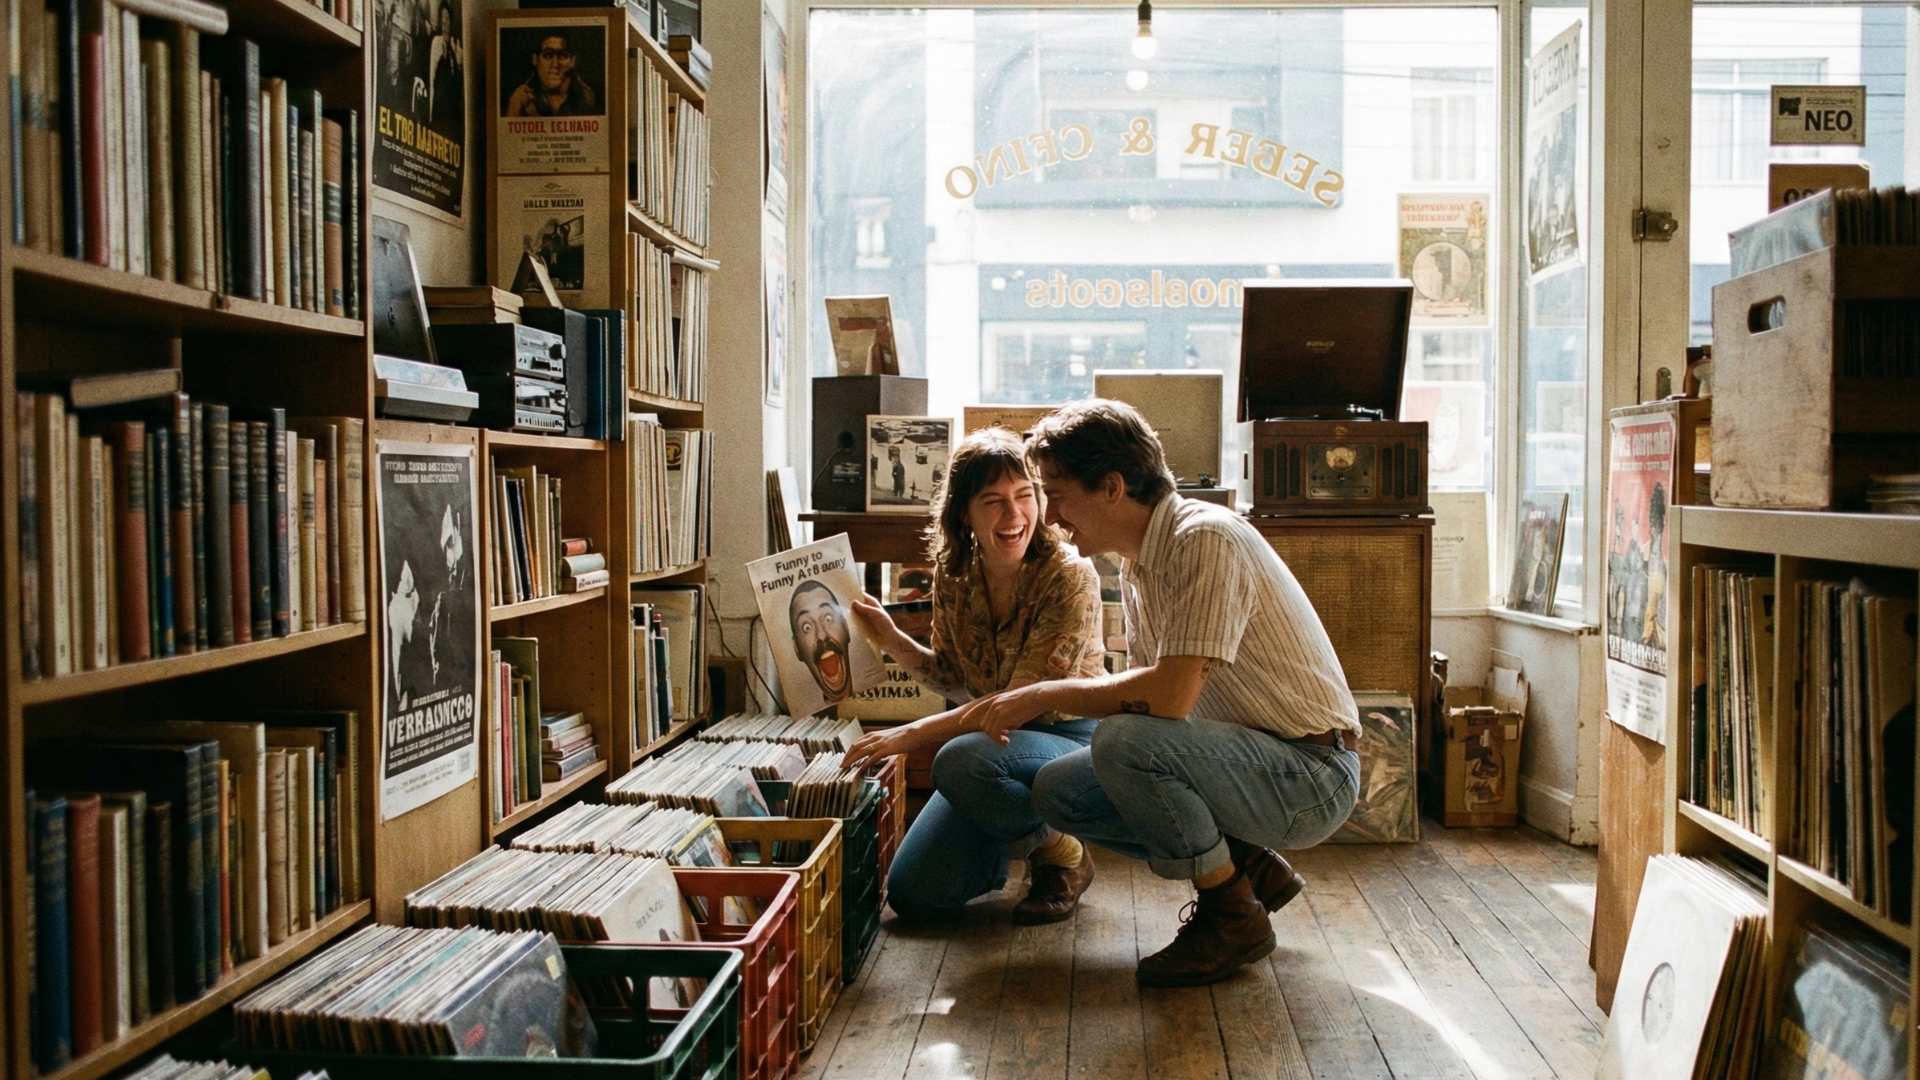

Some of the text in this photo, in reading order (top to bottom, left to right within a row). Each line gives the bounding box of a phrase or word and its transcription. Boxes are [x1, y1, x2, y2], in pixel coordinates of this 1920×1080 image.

[379, 105, 394, 138] EL
[1805, 109, 1853, 131] NEO
[775, 551, 823, 574] Funny to
[760, 574, 794, 593] Funny
